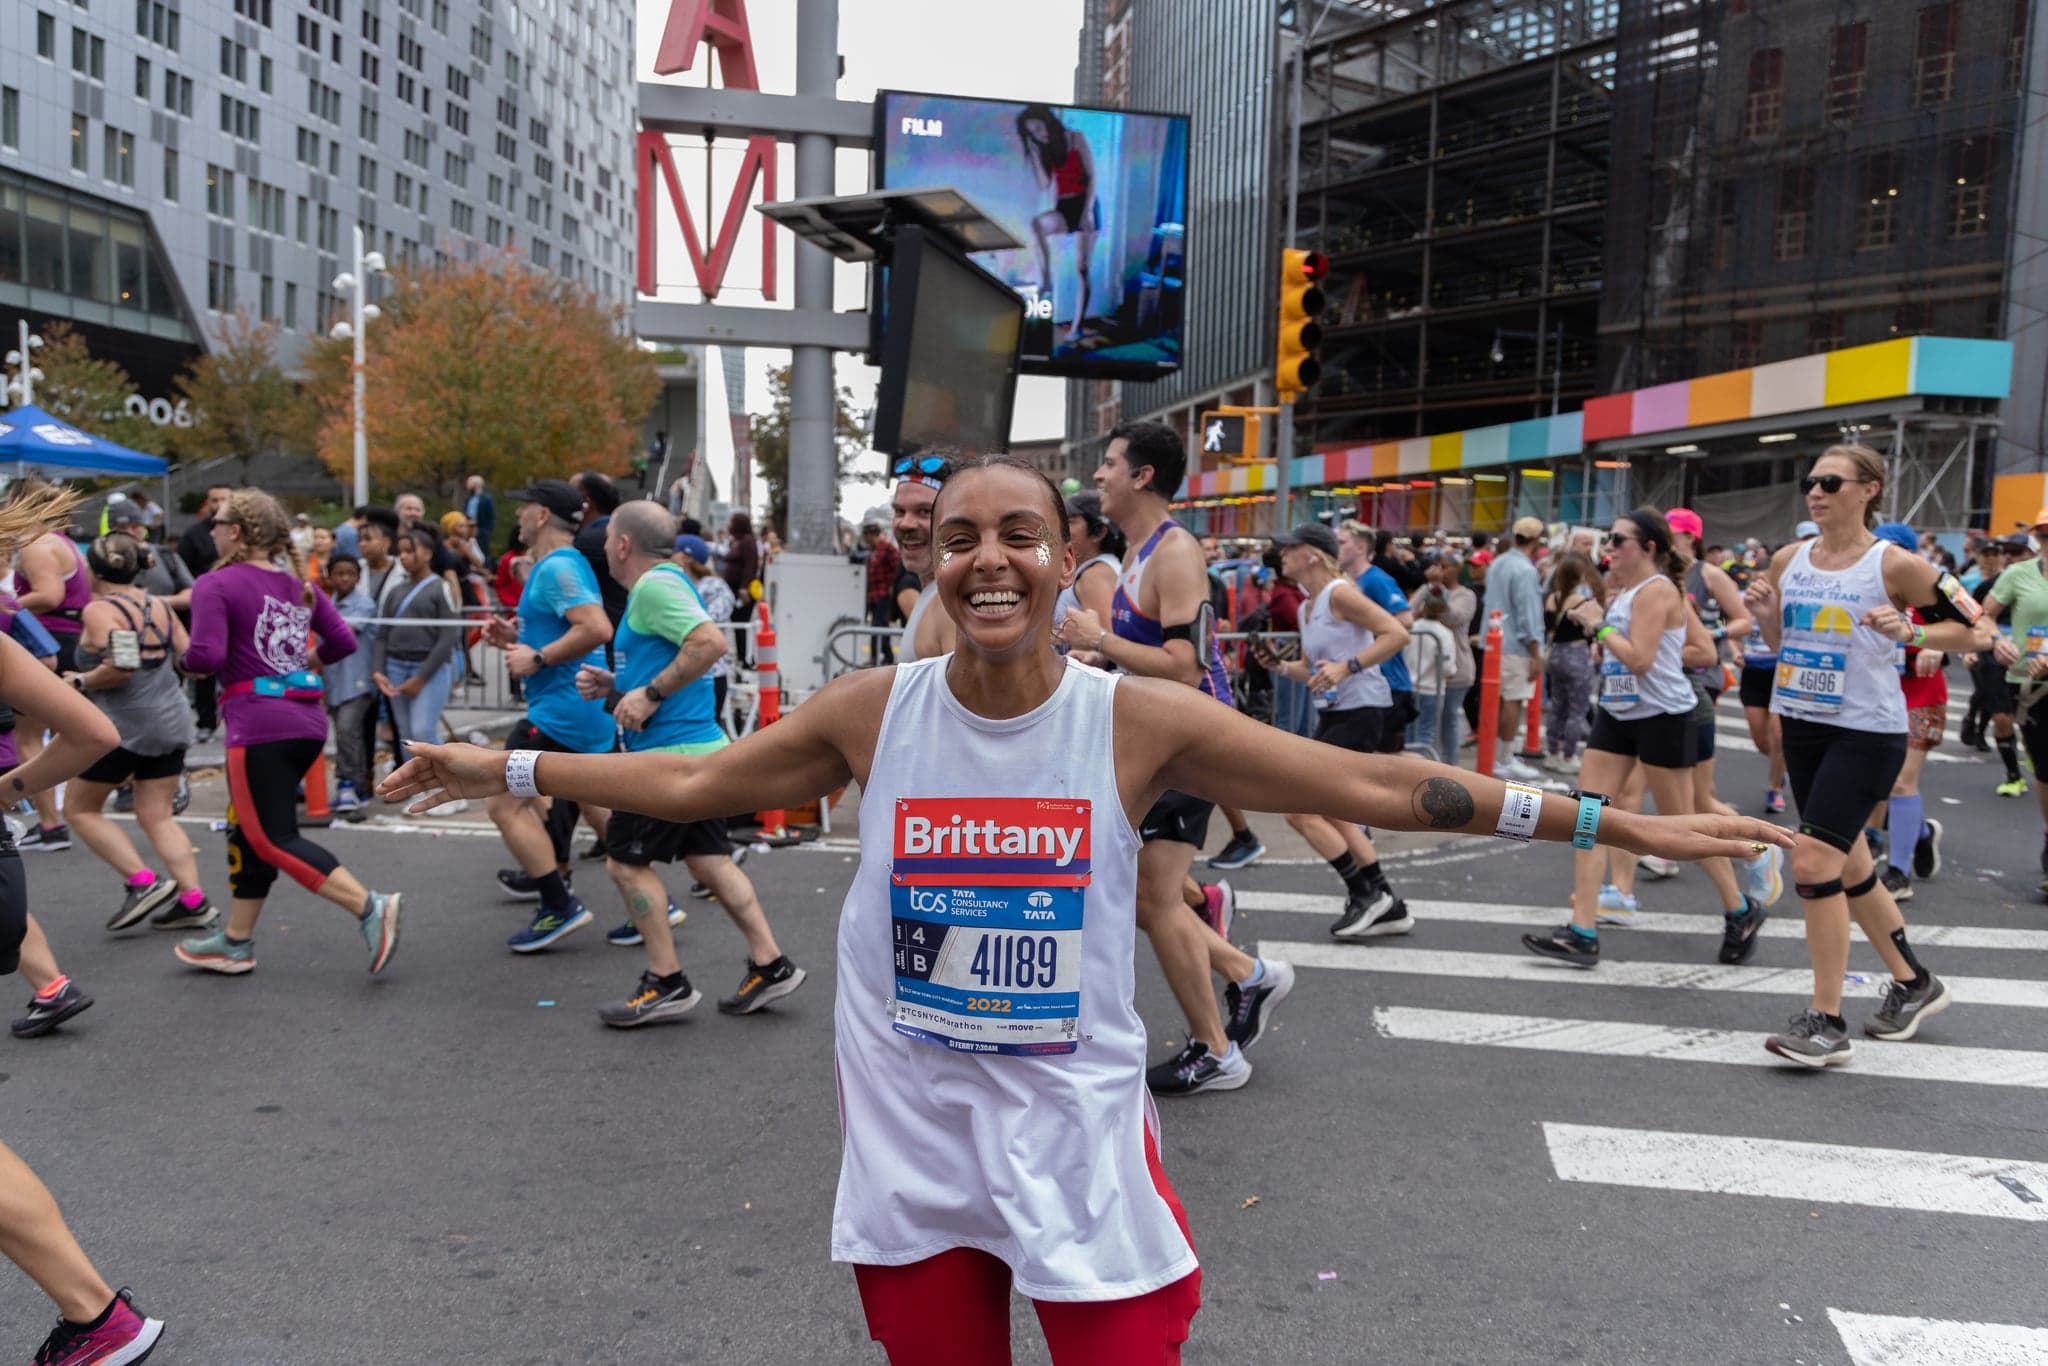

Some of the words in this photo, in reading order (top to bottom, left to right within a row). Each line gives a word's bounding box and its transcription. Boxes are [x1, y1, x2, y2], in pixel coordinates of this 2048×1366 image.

[901, 117, 943, 137] FILM
[1799, 670, 1836, 693] 46196
[904, 814, 1084, 867] Brittany
[951, 889, 976, 898] TATA
[951, 898, 1009, 909] CONSULTANCY
[951, 907, 988, 917] SERVICES
[1023, 910, 1056, 920] TATA
[911, 927, 926, 945] 4
[913, 953, 928, 972] B
[970, 933, 1058, 989] 41189
[966, 997, 1012, 1013] 2022
[901, 1007, 983, 1031] #TCSNYCMarathon
